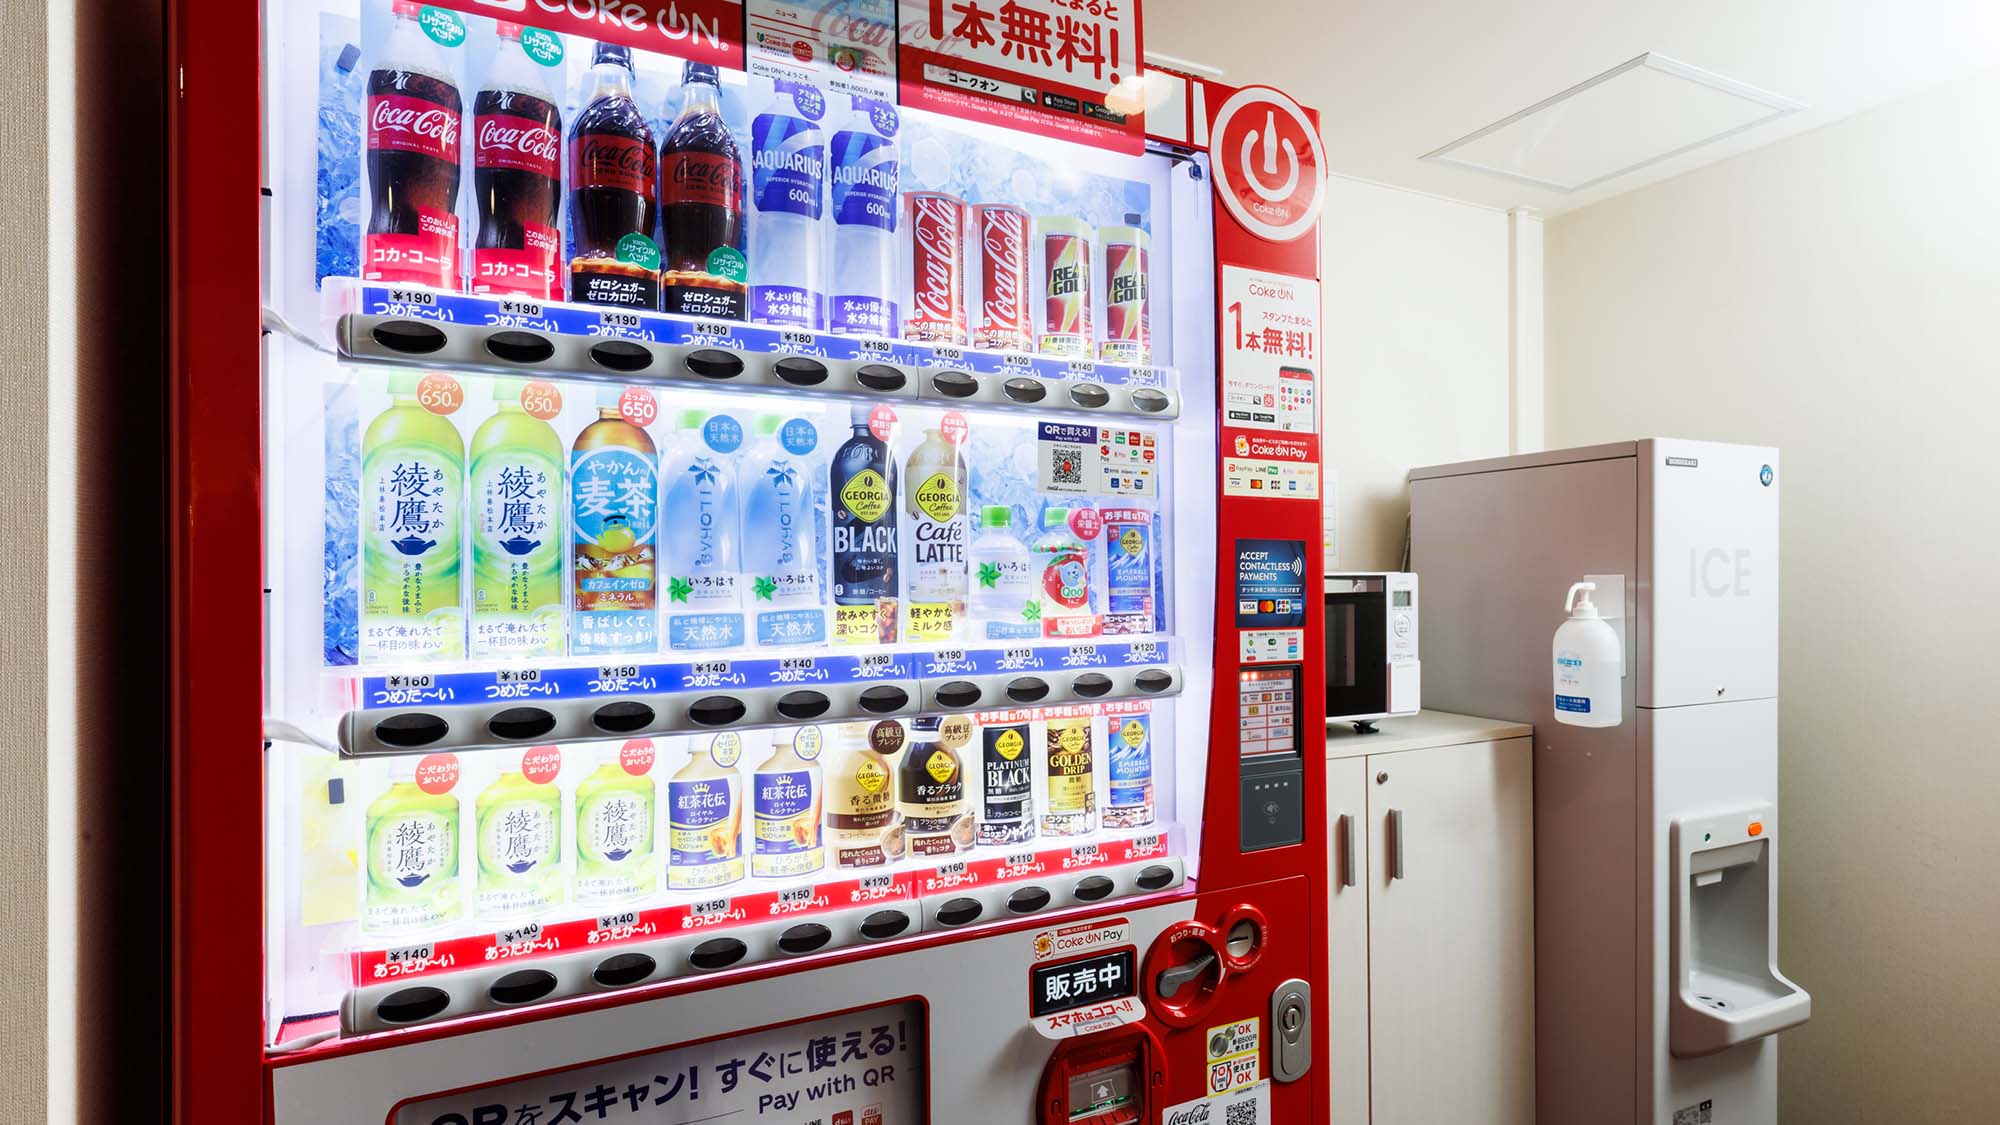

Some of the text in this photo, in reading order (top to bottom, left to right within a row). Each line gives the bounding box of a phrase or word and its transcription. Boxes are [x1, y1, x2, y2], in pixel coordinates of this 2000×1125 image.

[776, 9, 798, 19] ニュース
[949, 73, 999, 92] コークオン
[373, 99, 459, 146] Coca-Cola
[480, 119, 559, 161] Coca-Cola
[582, 139, 656, 178] Coca-Cola
[755, 150, 822, 179] AQUARIUS
[834, 166, 897, 193] AQUARIUS
[1253, 202, 1274, 216] Coke
[373, 247, 452, 270] コカ・コーラ
[915, 198, 956, 322] Coca-Cola
[481, 262, 556, 282] コカ・コーラ
[984, 210, 1022, 330] Coca-Cola
[589, 279, 646, 293] ゼロシュガー
[1249, 284, 1276, 298] Coke
[392, 290, 432, 304] ¥190
[683, 292, 736, 305] ゼロシュガー
[503, 301, 539, 315] ¥190
[604, 314, 637, 326] ¥190
[1262, 311, 1312, 327] スタンプたまると
[696, 324, 728, 335] ¥190
[1228, 302, 1313, 360] 1本無料!
[784, 333, 811, 344] ¥180
[864, 340, 889, 351] ¥180
[936, 348, 959, 358] ¥100
[1006, 356, 1028, 365] ¥100
[1072, 363, 1091, 371] ¥140
[1132, 369, 1151, 377] ¥140
[622, 402, 654, 418] 650
[709, 422, 738, 432] 日本の
[786, 426, 814, 436] 日本の
[709, 432, 740, 443] 天然水
[786, 437, 815, 446] 天然水
[1251, 445, 1307, 461] Coke ON Pay
[390, 462, 432, 534] 綾鷹
[432, 469, 445, 529] あやたか
[497, 465, 537, 534] 綾鷹
[536, 471, 548, 529] あやたか
[576, 476, 655, 518] 麦茶
[845, 491, 888, 501] GEORGIA
[919, 493, 960, 503] GEORGIA
[856, 501, 880, 511] Coffee
[929, 503, 952, 512] Coffee
[916, 522, 962, 542] Café
[835, 526, 897, 553] BLACK
[916, 543, 963, 563] LATTE
[1240, 552, 1268, 560] ACCEPT
[1240, 562, 1290, 571] CONTACTLESS
[1689, 547, 1751, 598] ICE
[1240, 573, 1277, 581] PAYMENTS
[588, 580, 645, 589] カフェインゼロ
[600, 593, 634, 602] ミネラル
[1062, 587, 1083, 598] Qoo
[836, 608, 887, 621] 飲みやすく
[910, 608, 952, 618] 軽やかな
[771, 622, 816, 637] 天然水
[836, 623, 878, 635] 深いコク
[912, 620, 952, 631] ミルク感
[579, 631, 652, 646] 後味すっきり
[684, 625, 733, 641] 天然水
[367, 639, 443, 651] 一杯目の味わい
[478, 636, 549, 647] 一杯目の味わい
[1134, 643, 1154, 652] ¥120
[938, 651, 961, 659] ¥190
[1007, 649, 1030, 658] ¥110
[1072, 646, 1094, 655] ¥150
[783, 659, 812, 668] ¥140
[864, 656, 889, 665] ¥180
[603, 667, 636, 677] ¥150
[695, 663, 726, 673] ¥140
[390, 676, 429, 687] ¥160
[501, 670, 537, 681] ¥160
[877, 728, 902, 739] 高級豆
[945, 724, 970, 734] 高級豆
[878, 737, 901, 746] ブレンド
[946, 733, 968, 741] ブレンド
[998, 740, 1024, 749] GEORGIA
[524, 754, 560, 765] こだわりの
[987, 758, 1029, 770] PLATINUM
[1050, 753, 1092, 767] GOLDEN
[418, 764, 458, 775] こだわりの
[1063, 765, 1085, 775] DRIP
[987, 768, 1030, 788] BLACK
[762, 784, 808, 800] 紅茶花伝
[917, 782, 962, 796] 香るブラック
[677, 792, 726, 809] 紅茶花伝
[850, 792, 890, 806] 香る微糖
[769, 807, 801, 815] ミルクティー
[602, 799, 628, 848] 綾鷹
[686, 816, 719, 824] ミルクティー
[505, 809, 533, 858] 綾鷹
[396, 820, 425, 872] 綾鷹
[1136, 837, 1157, 846] ¥120
[1075, 847, 1097, 856] ¥120
[1009, 855, 1032, 863] ¥110
[941, 862, 963, 873] ¥160
[864, 877, 889, 887] ¥170
[783, 890, 810, 902] ¥150
[696, 900, 725, 913] ¥150
[602, 913, 634, 928] ¥140
[504, 923, 538, 942] ¥140
[1057, 929, 1123, 949] Coke ON Pay
[390, 948, 428, 962] ¥140
[1046, 962, 1120, 1002] 販売中
[1048, 1000, 1133, 1029] スマホはココへ!!
[1238, 1024, 1251, 1034] OK
[715, 1020, 907, 1093] すぐに使える!
[1233, 1060, 1255, 1073] 使えます
[1236, 1071, 1251, 1084] OK
[759, 1065, 895, 1114] Pay with QR
